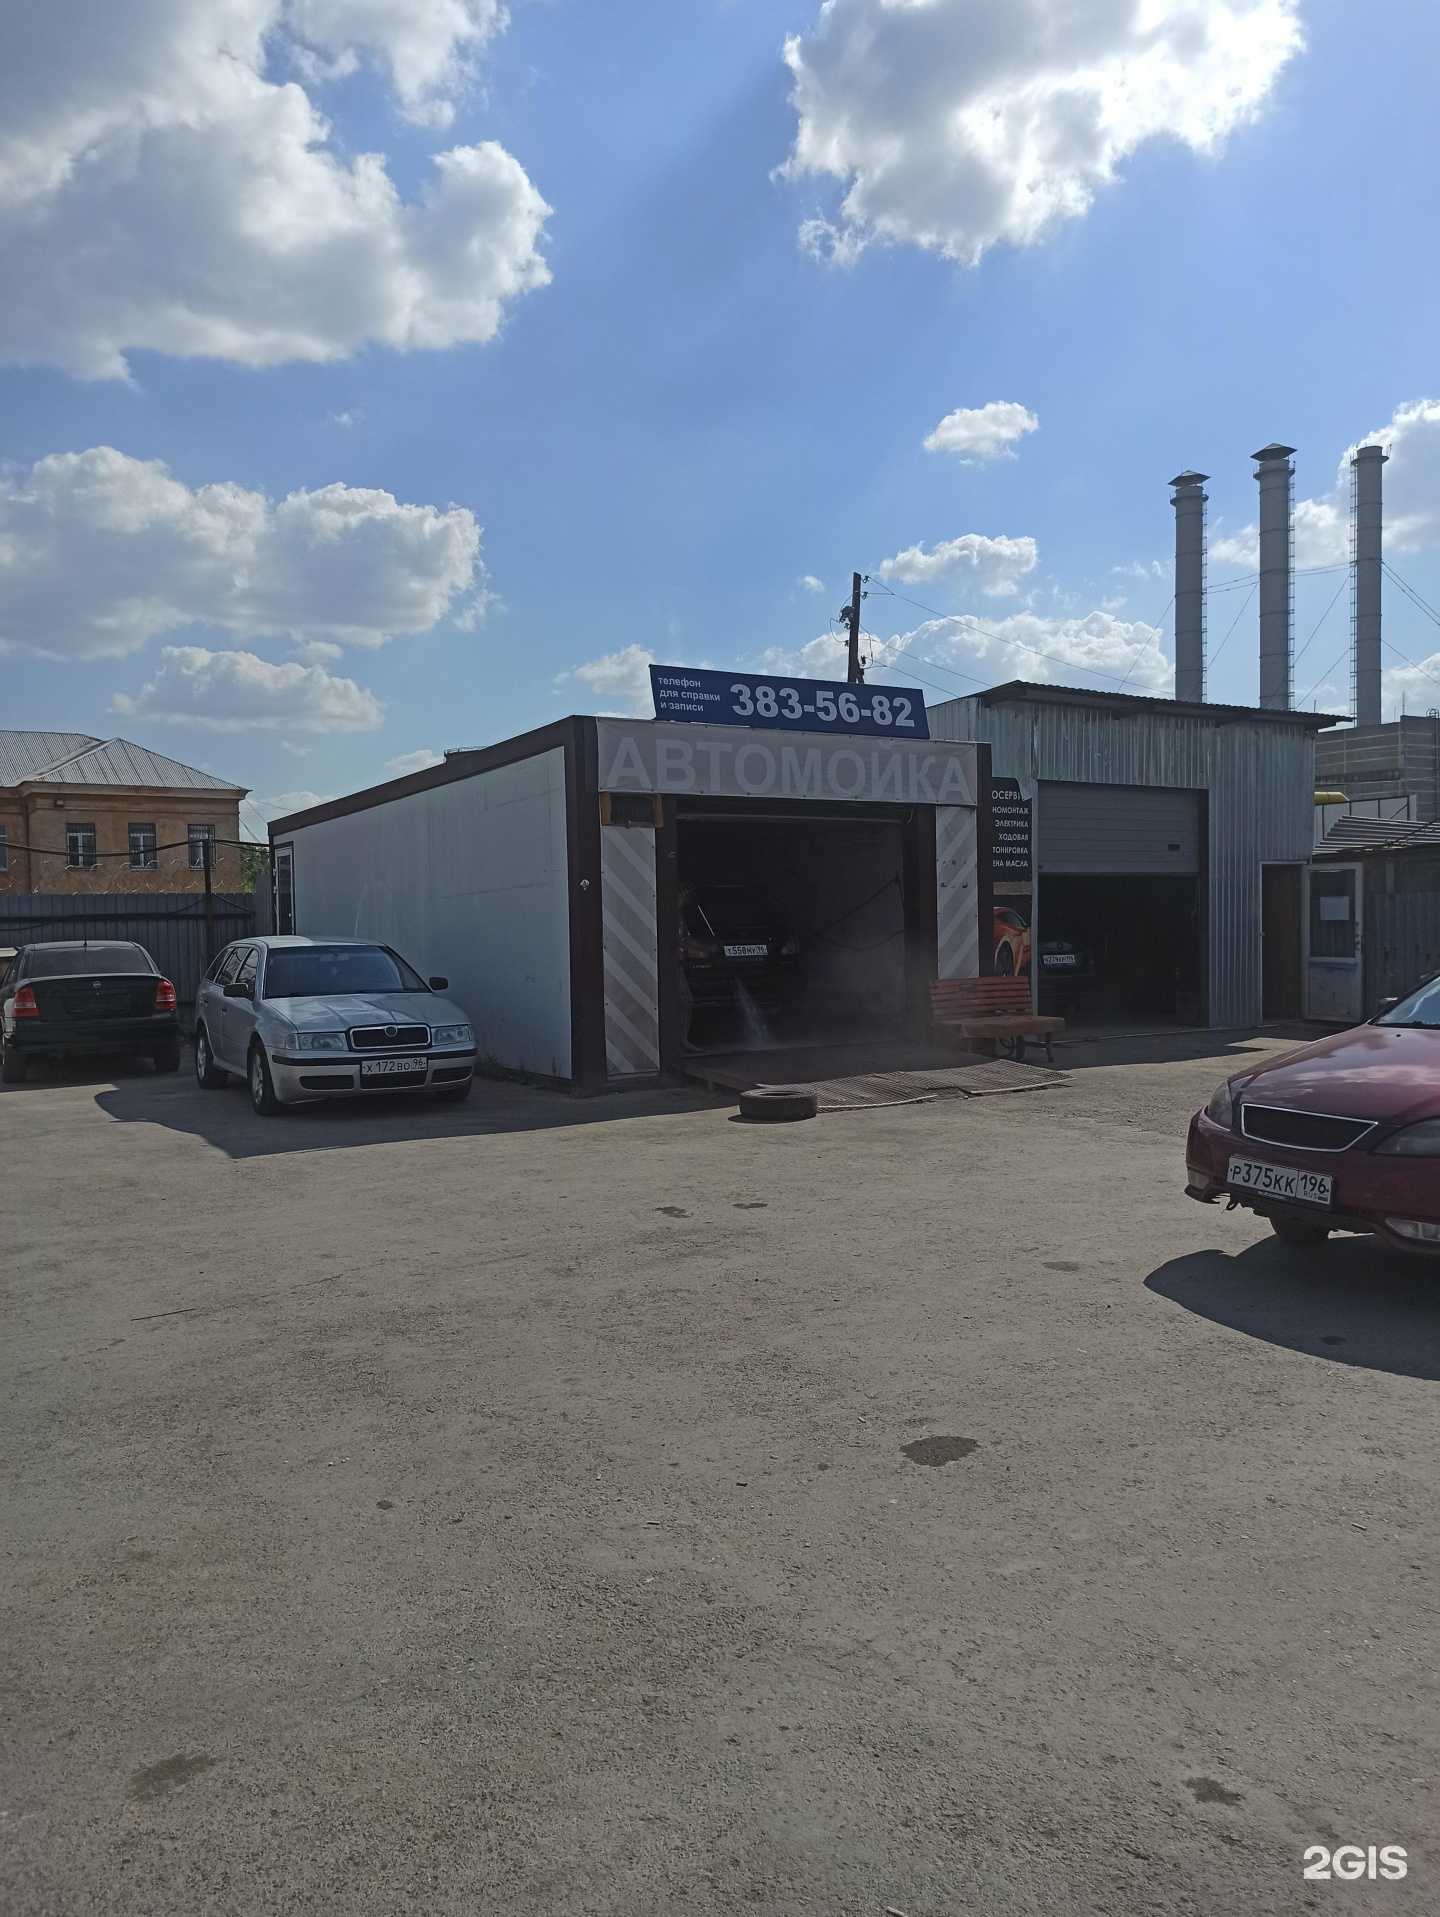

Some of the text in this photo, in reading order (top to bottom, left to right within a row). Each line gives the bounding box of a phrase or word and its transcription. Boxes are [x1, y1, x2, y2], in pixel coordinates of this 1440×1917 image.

[658, 677, 701, 688] телефон
[660, 690, 720, 701] для справки
[660, 701, 704, 711] и записи
[730, 683, 915, 727] 383-56-82
[607, 736, 976, 800] АВТОМОЙКА
[994, 820, 1029, 828] ЭЛЕКТРИКА
[999, 833, 1029, 841] ХОДОВАЯ
[1005, 860, 1029, 868] МАСЛА
[1300, 1174, 1327, 1194] 196
